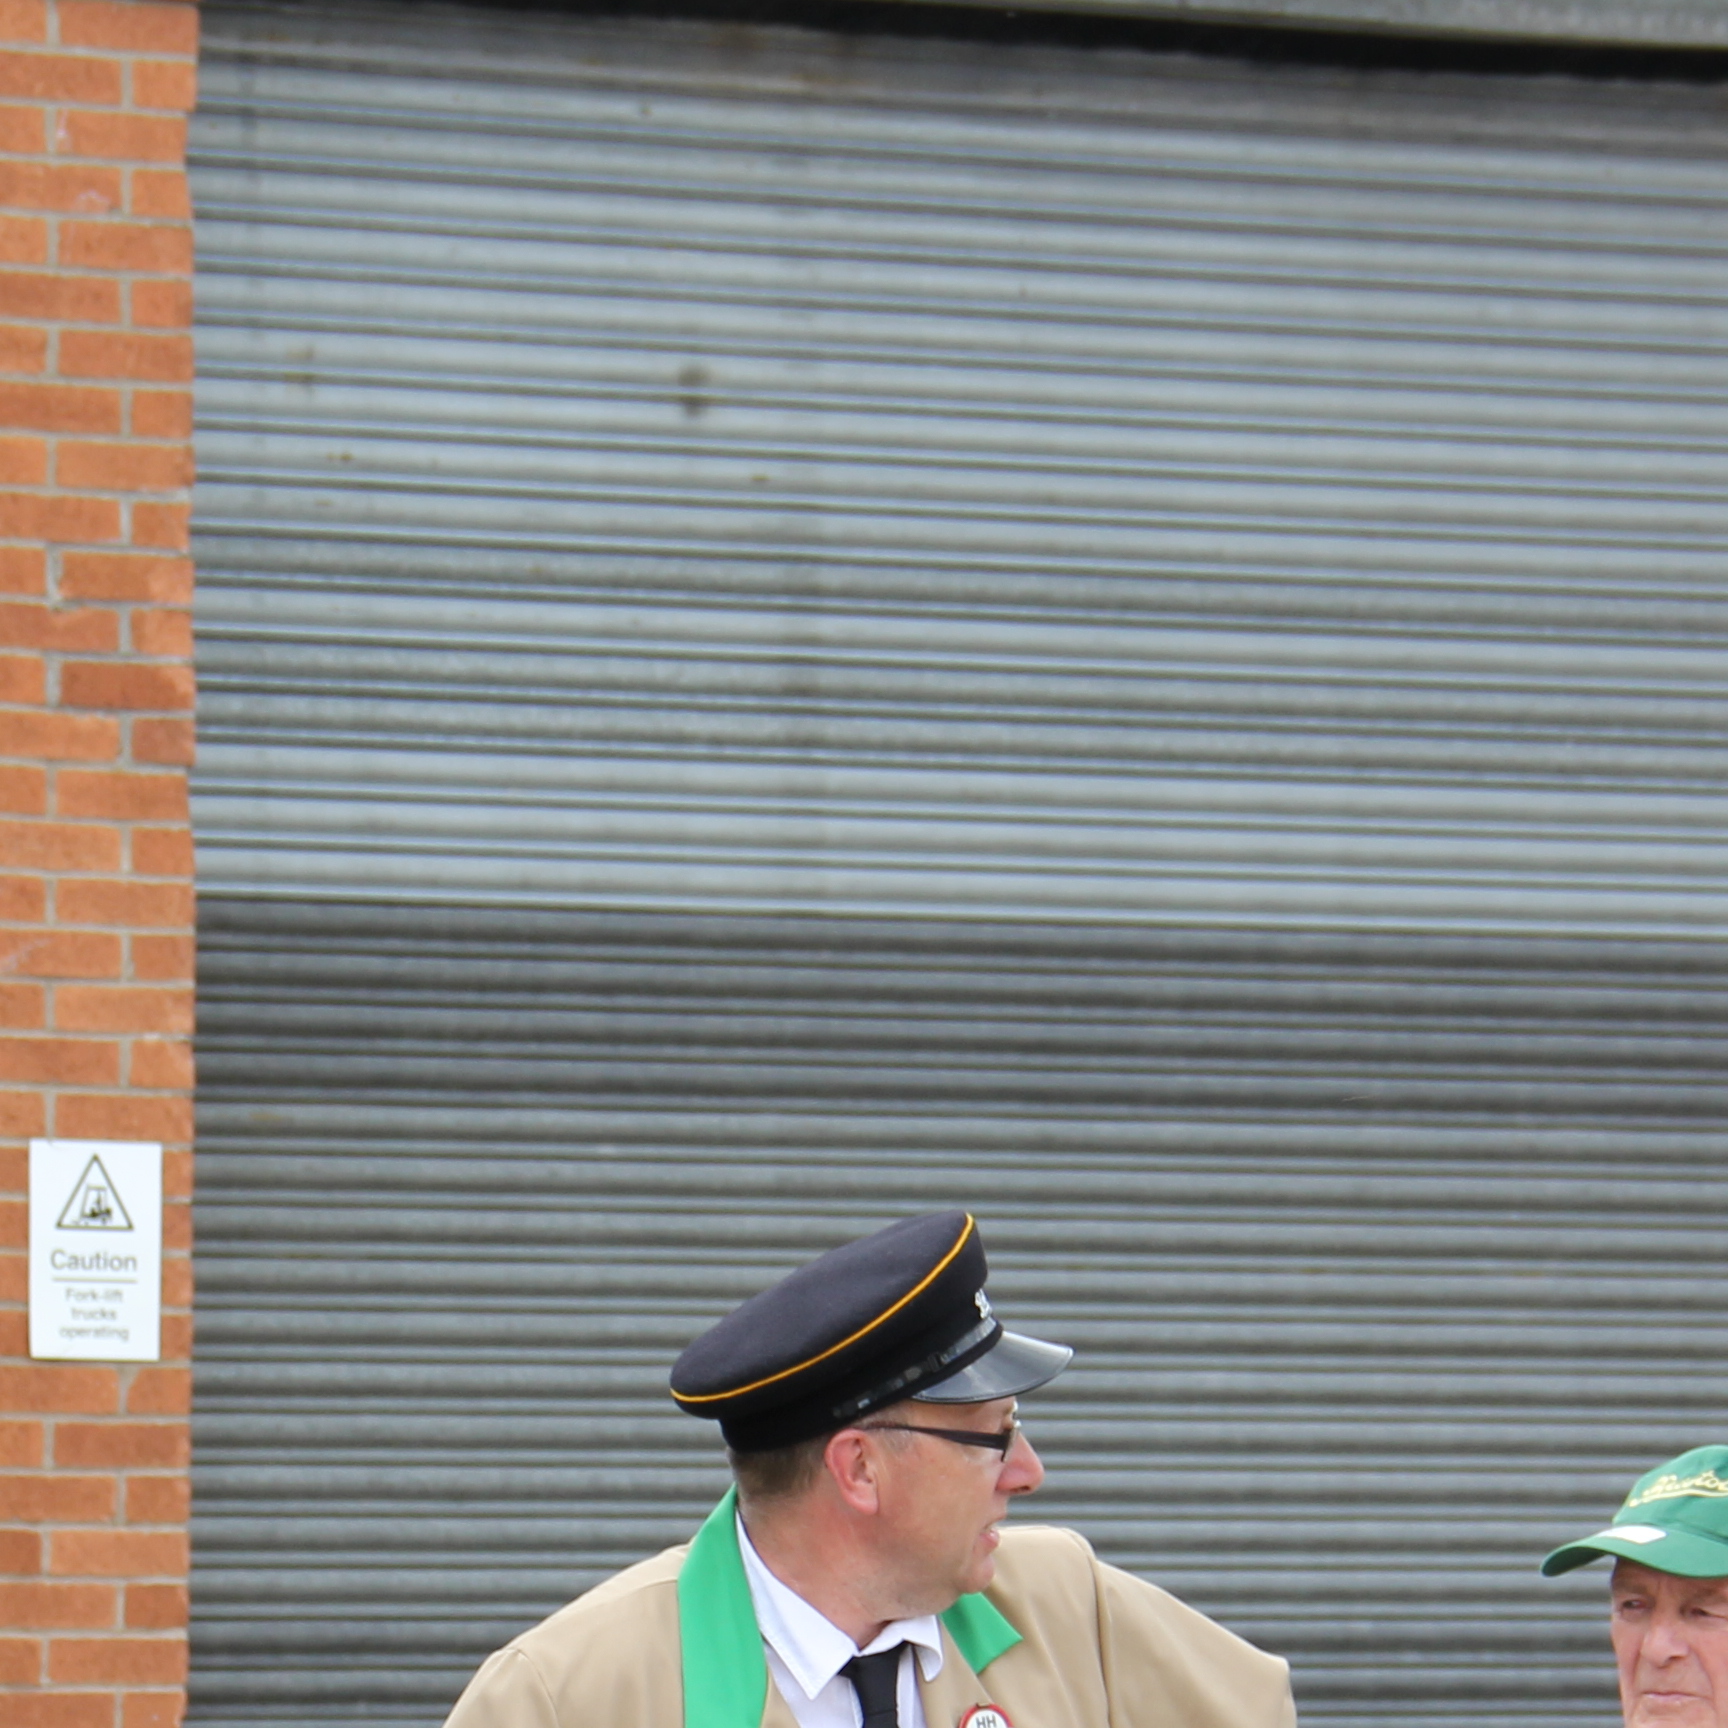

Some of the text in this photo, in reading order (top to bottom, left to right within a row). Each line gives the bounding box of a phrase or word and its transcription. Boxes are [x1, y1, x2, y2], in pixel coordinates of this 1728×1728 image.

[50, 1250, 137, 1272] Caution
[71, 1307, 117, 1320] trucks
[59, 1326, 129, 1341] operating
